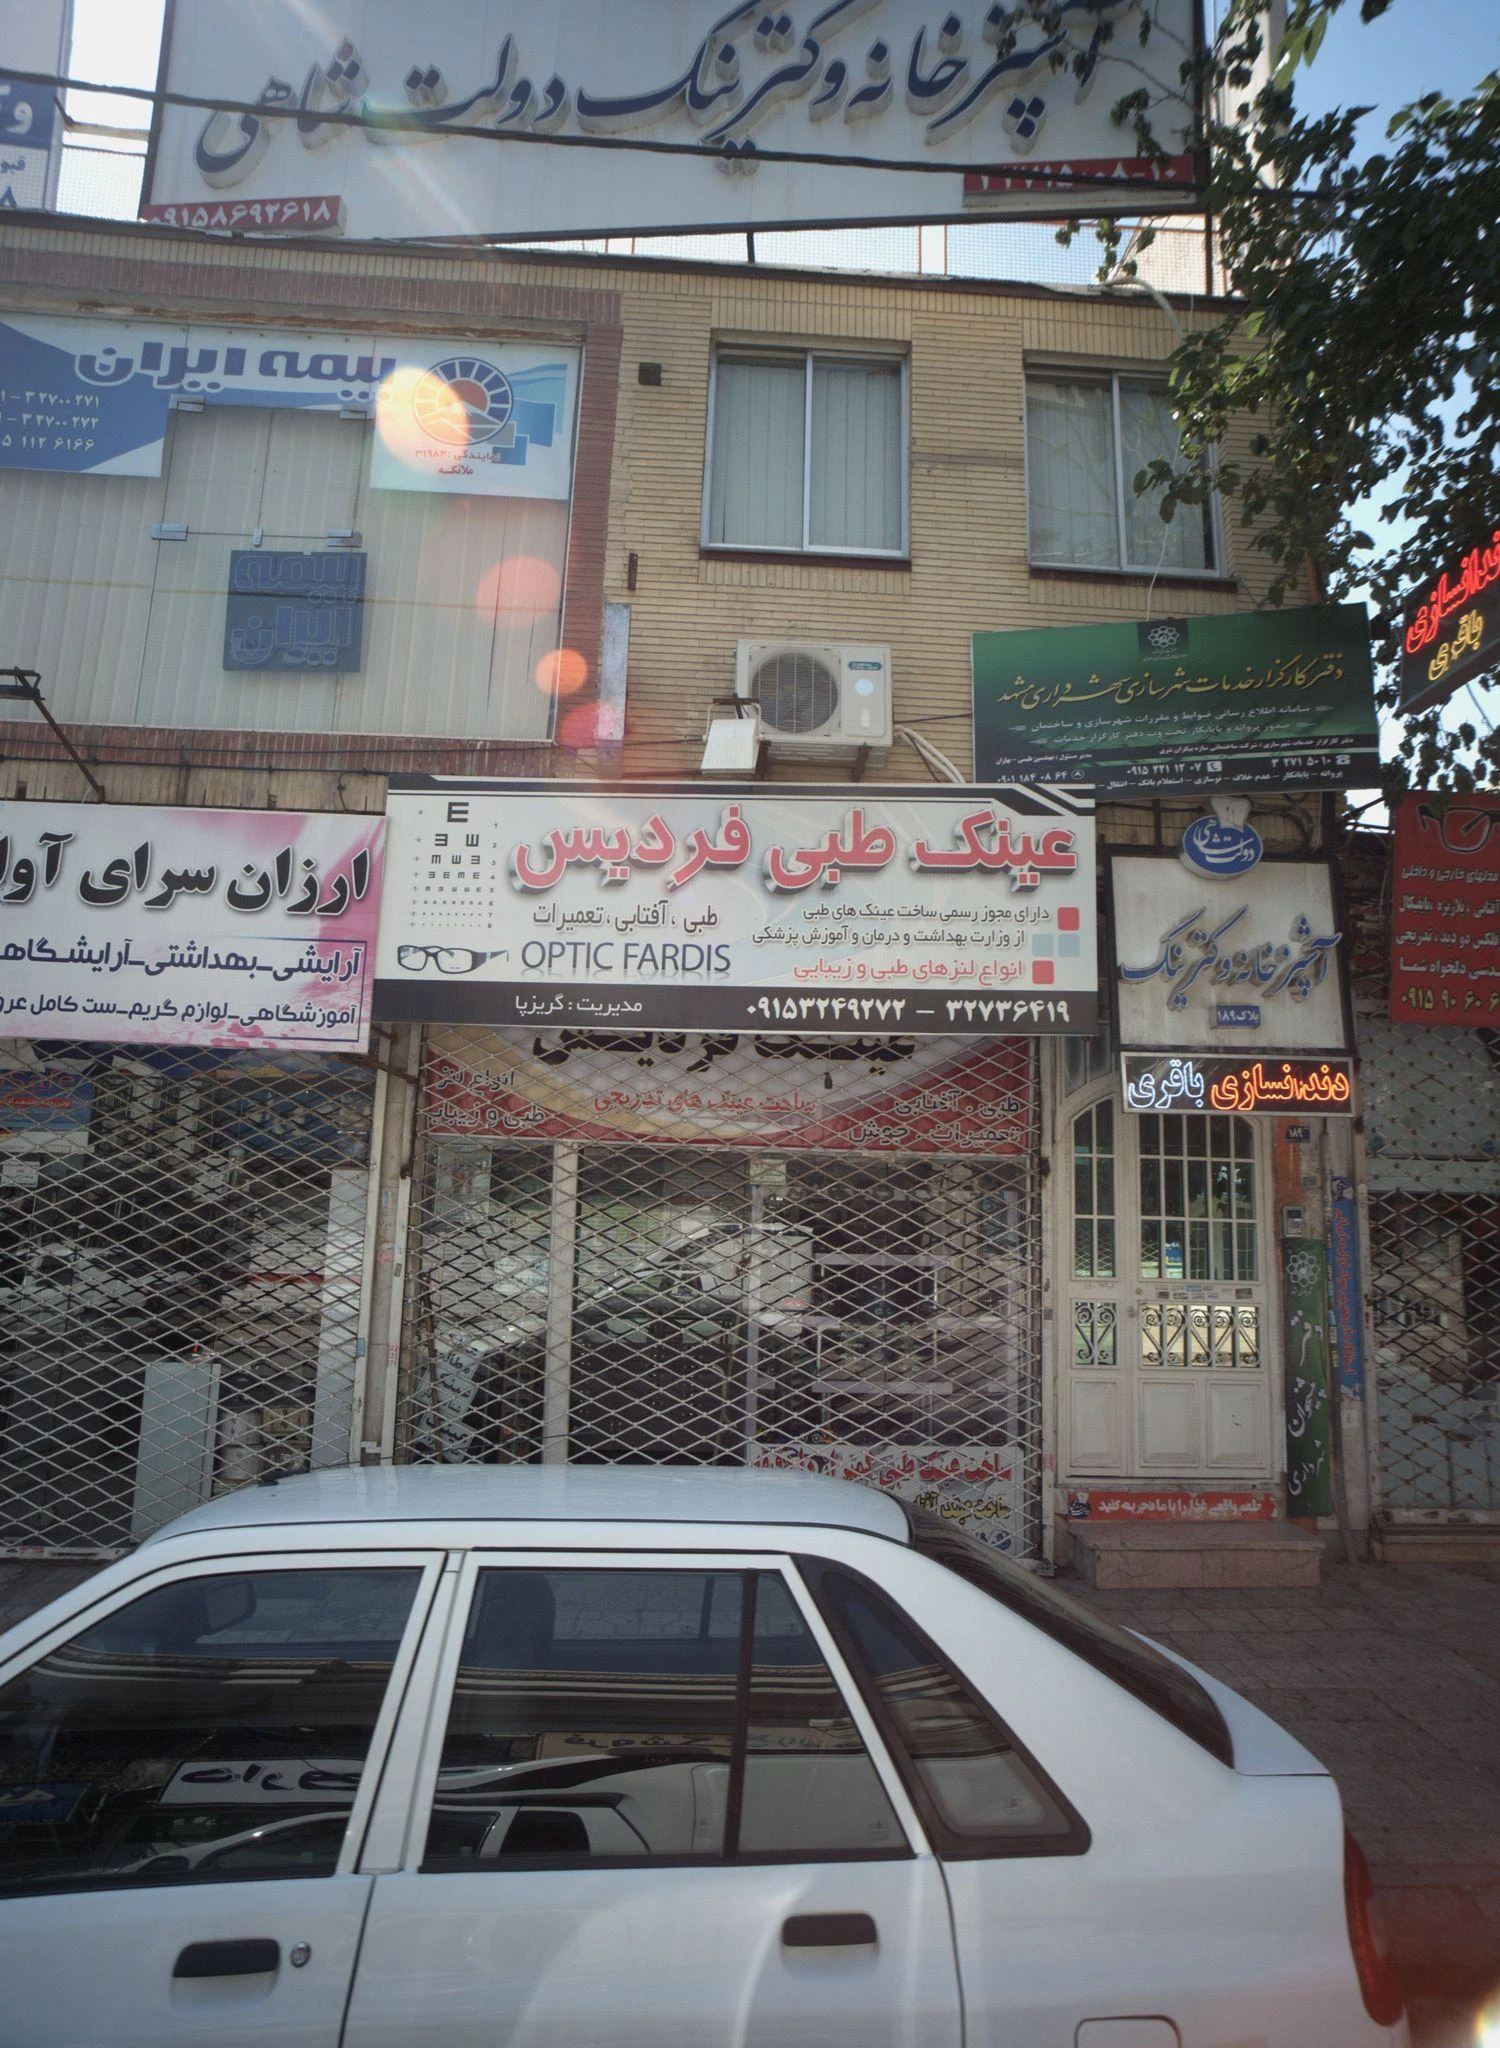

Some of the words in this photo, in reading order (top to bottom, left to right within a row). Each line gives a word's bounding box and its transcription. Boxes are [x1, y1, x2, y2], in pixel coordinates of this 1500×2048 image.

[76, 340, 246, 393] ایران
[257, 347, 398, 400] بیمه
[512, 803, 753, 891] فردیس
[767, 806, 897, 892] طبی
[914, 808, 1078, 889] عینک
[79, 840, 217, 908] سرای
[226, 845, 370, 916] ارزان
[533, 902, 604, 931] تعمیرات
[614, 899, 669, 932] آفتابی
[684, 905, 718, 933] طبی
[803, 903, 830, 920] طبی
[831, 903, 856, 921] های
[859, 903, 895, 921] عینک
[897, 904, 937, 919] ساخت
[939, 907, 978, 922] رسمی
[981, 905, 1012, 922] مجوز
[1014, 905, 1050, 923] دارای
[752, 926, 799, 946] پزشکی
[801, 925, 848, 945] آموزش
[851, 933, 859, 945] و
[862, 928, 900, 946] درمان
[903, 935, 911, 946] و
[913, 928, 968, 946] بهداشت
[970, 929, 1010, 947] وزارت
[1014, 929, 1025, 947] از
[521, 940, 614, 970] OPTIC
[623, 942, 732, 973] FARDIS
[793, 957, 852, 980] زیبایی
[856, 963, 867, 979] و
[870, 957, 908, 980] طبی
[979, 959, 1023, 986] انواع
[0, 995, 28, 1015] عرو
[29, 993, 79, 1015] کامل
[576, 996, 643, 1017] مدیریت
[1401, 986, 1435, 1010] ۰۹۱۵
[746, 995, 907, 1021] ۰۹۱۵۳۲۴۹۲۷۲
[945, 998, 1071, 1023] ۳۲۷۳۶۴۱۹
[1127, 1059, 1204, 1109] باقری
